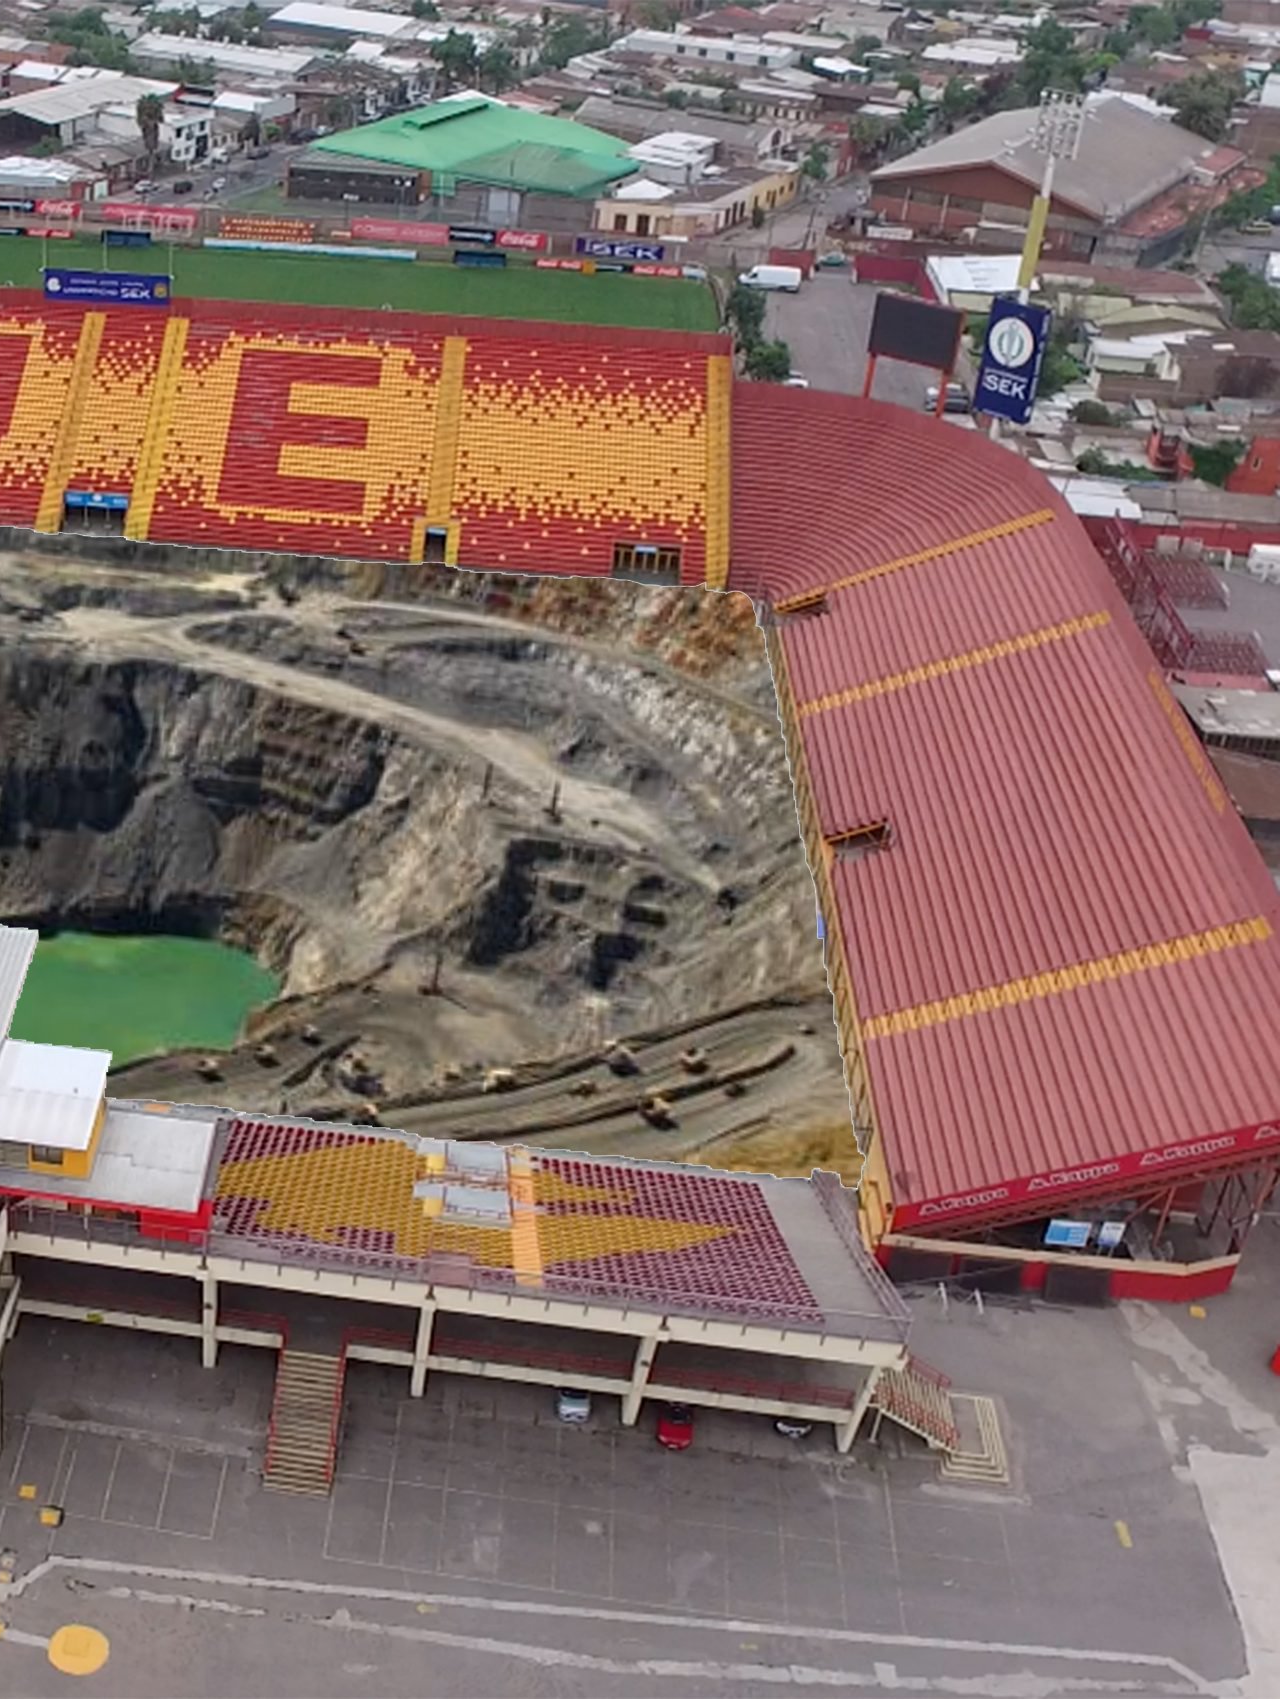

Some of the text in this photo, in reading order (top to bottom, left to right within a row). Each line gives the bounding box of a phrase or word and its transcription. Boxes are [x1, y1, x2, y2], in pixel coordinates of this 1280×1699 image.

[982, 374, 1027, 400] SEK
[219, 346, 384, 514] E
[1162, 1136, 1236, 1160] Kappa
[1050, 1163, 1119, 1186] Kappa
[941, 1187, 1009, 1210] Kappa
